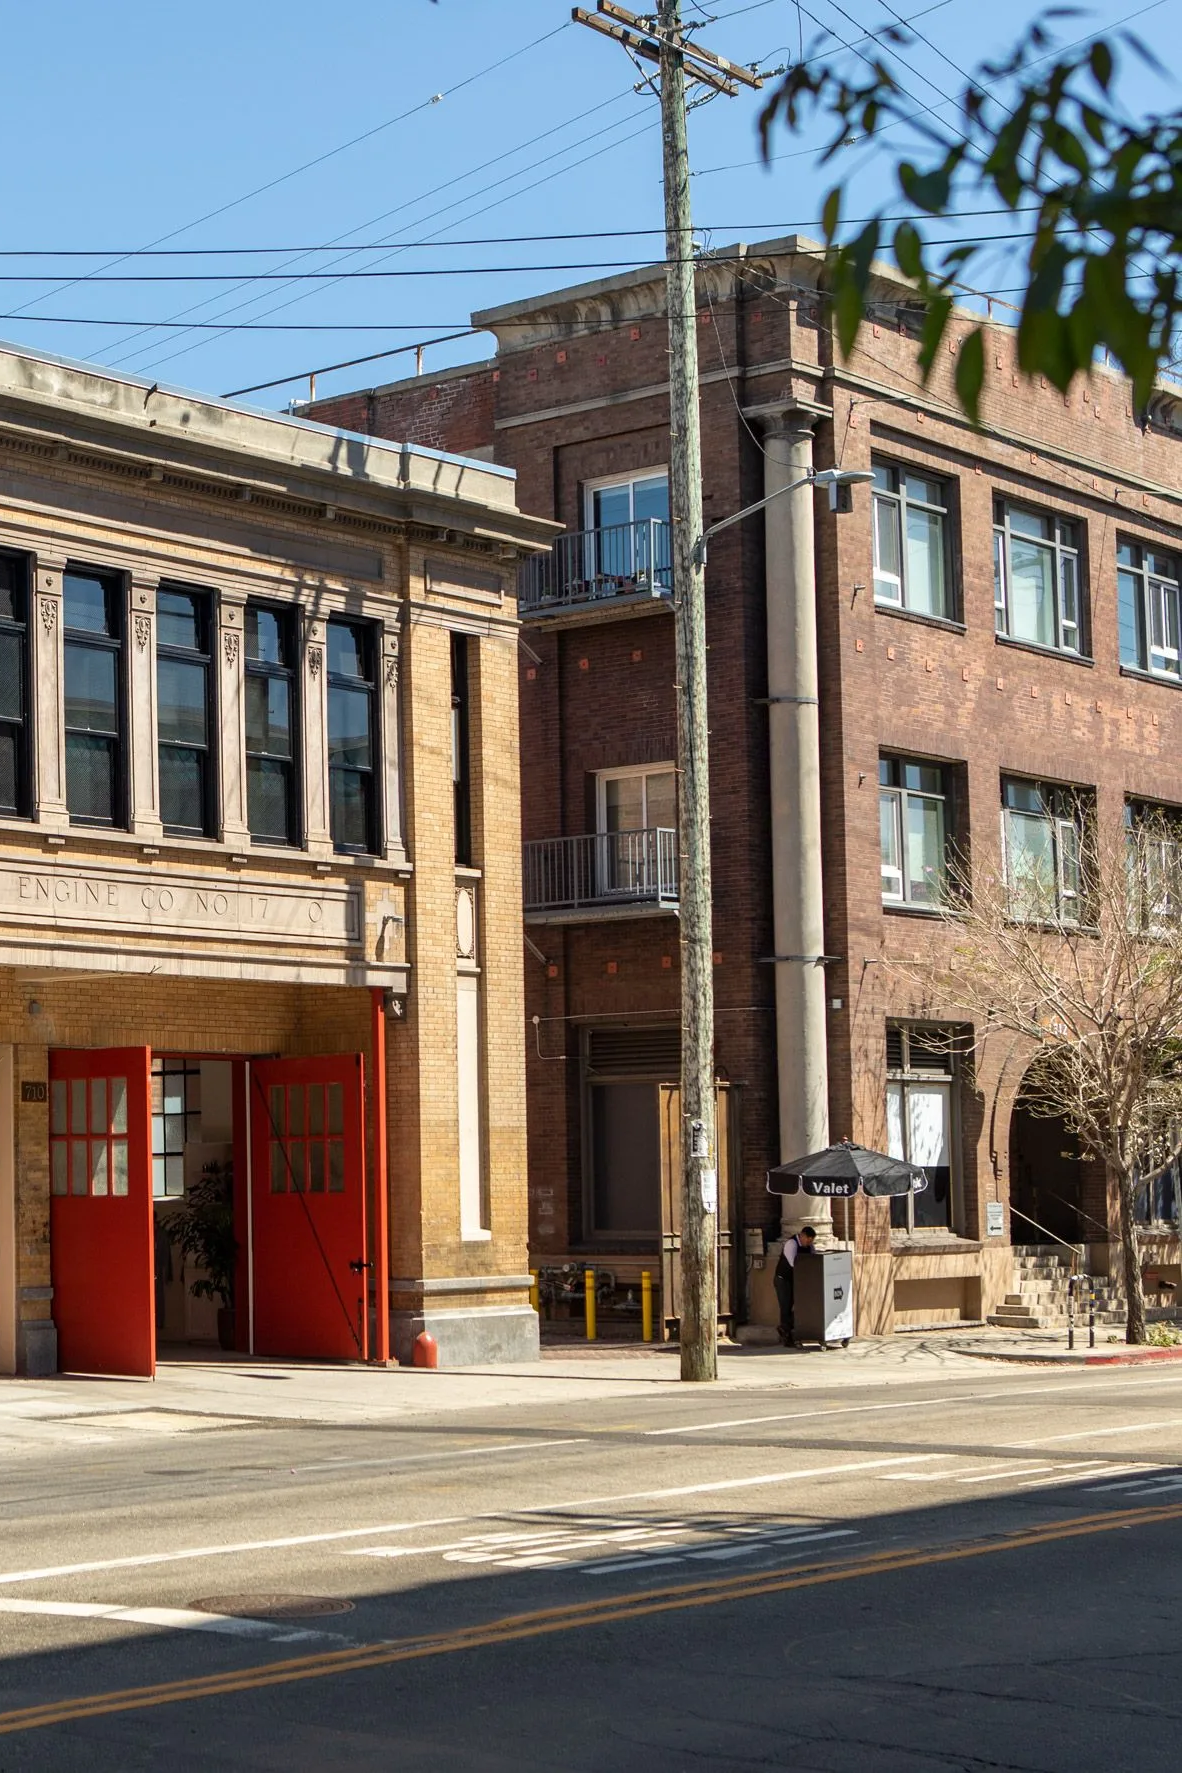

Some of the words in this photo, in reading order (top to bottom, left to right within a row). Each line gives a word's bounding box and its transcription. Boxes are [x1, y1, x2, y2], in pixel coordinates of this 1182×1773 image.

[18, 876, 119, 907] ENGINE
[249, 897, 269, 919] 17
[25, 1085, 45, 1100] 710
[812, 1182, 849, 1194] Valet
